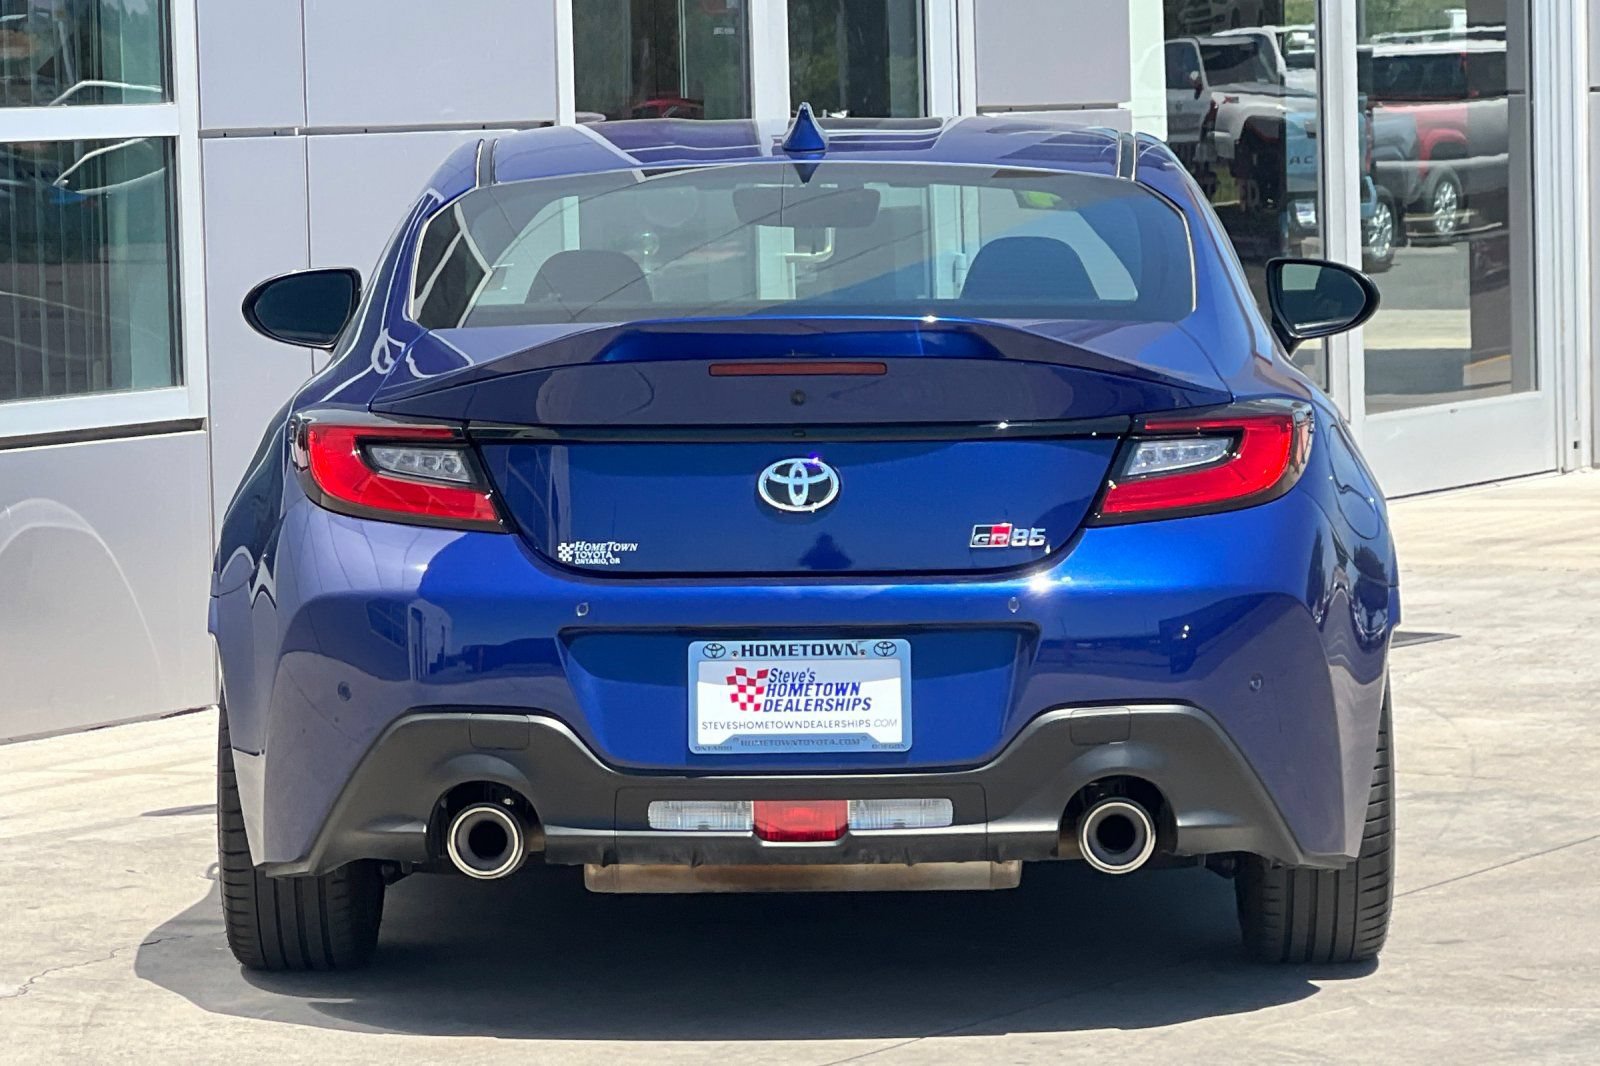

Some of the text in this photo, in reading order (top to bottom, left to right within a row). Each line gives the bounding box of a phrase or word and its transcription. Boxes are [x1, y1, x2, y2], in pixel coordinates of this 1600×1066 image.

[574, 551, 613, 559] TOYOTA
[741, 642, 859, 658] HOMETOWN
[768, 667, 816, 683] Steve's
[765, 681, 861, 698] HOMETOWN
[762, 697, 873, 713] DEALERSHIPS
